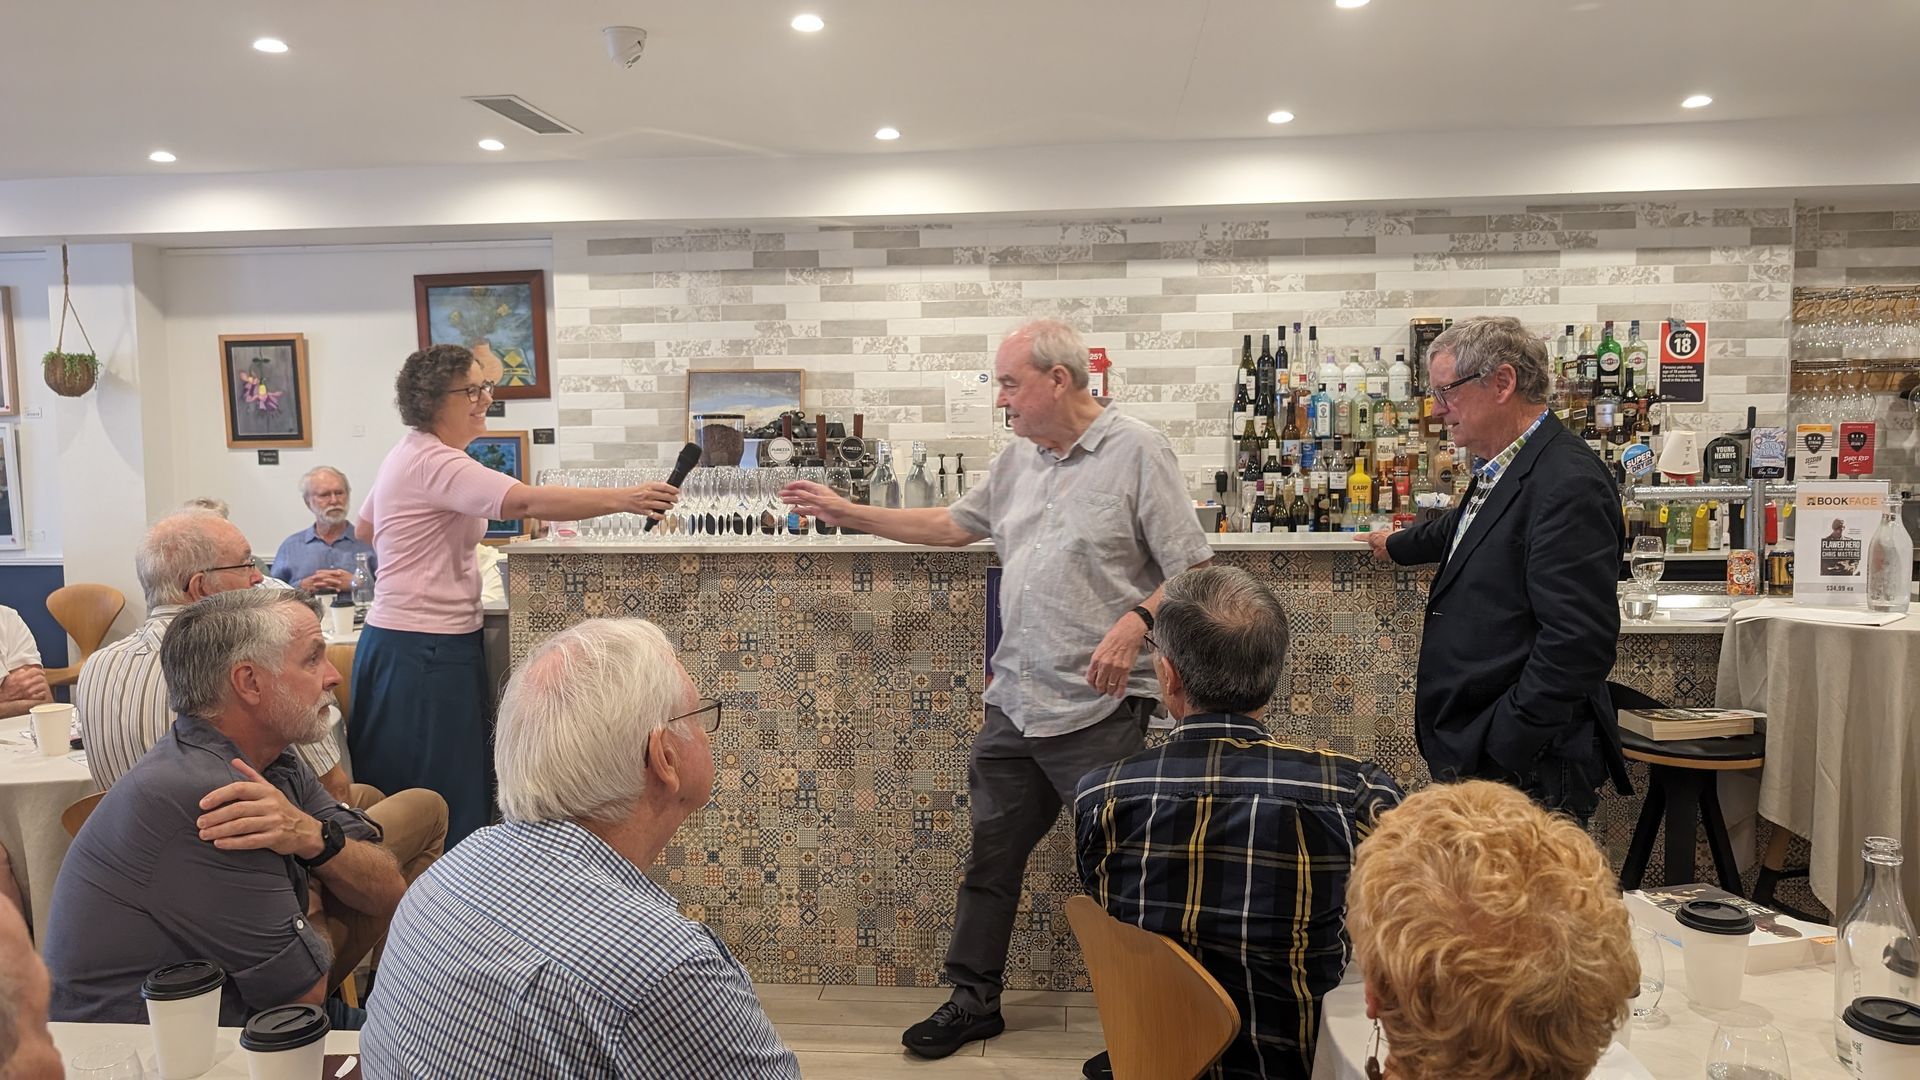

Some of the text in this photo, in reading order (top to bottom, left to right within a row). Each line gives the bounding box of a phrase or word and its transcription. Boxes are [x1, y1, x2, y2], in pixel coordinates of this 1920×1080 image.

[1674, 338, 1691, 353] 18
[1626, 450, 1651, 468] SUPER
[1632, 462, 1645, 473] DRY
[1817, 497, 1877, 506] BOOKFACE
[1822, 540, 1861, 549] FLAWED HERO
